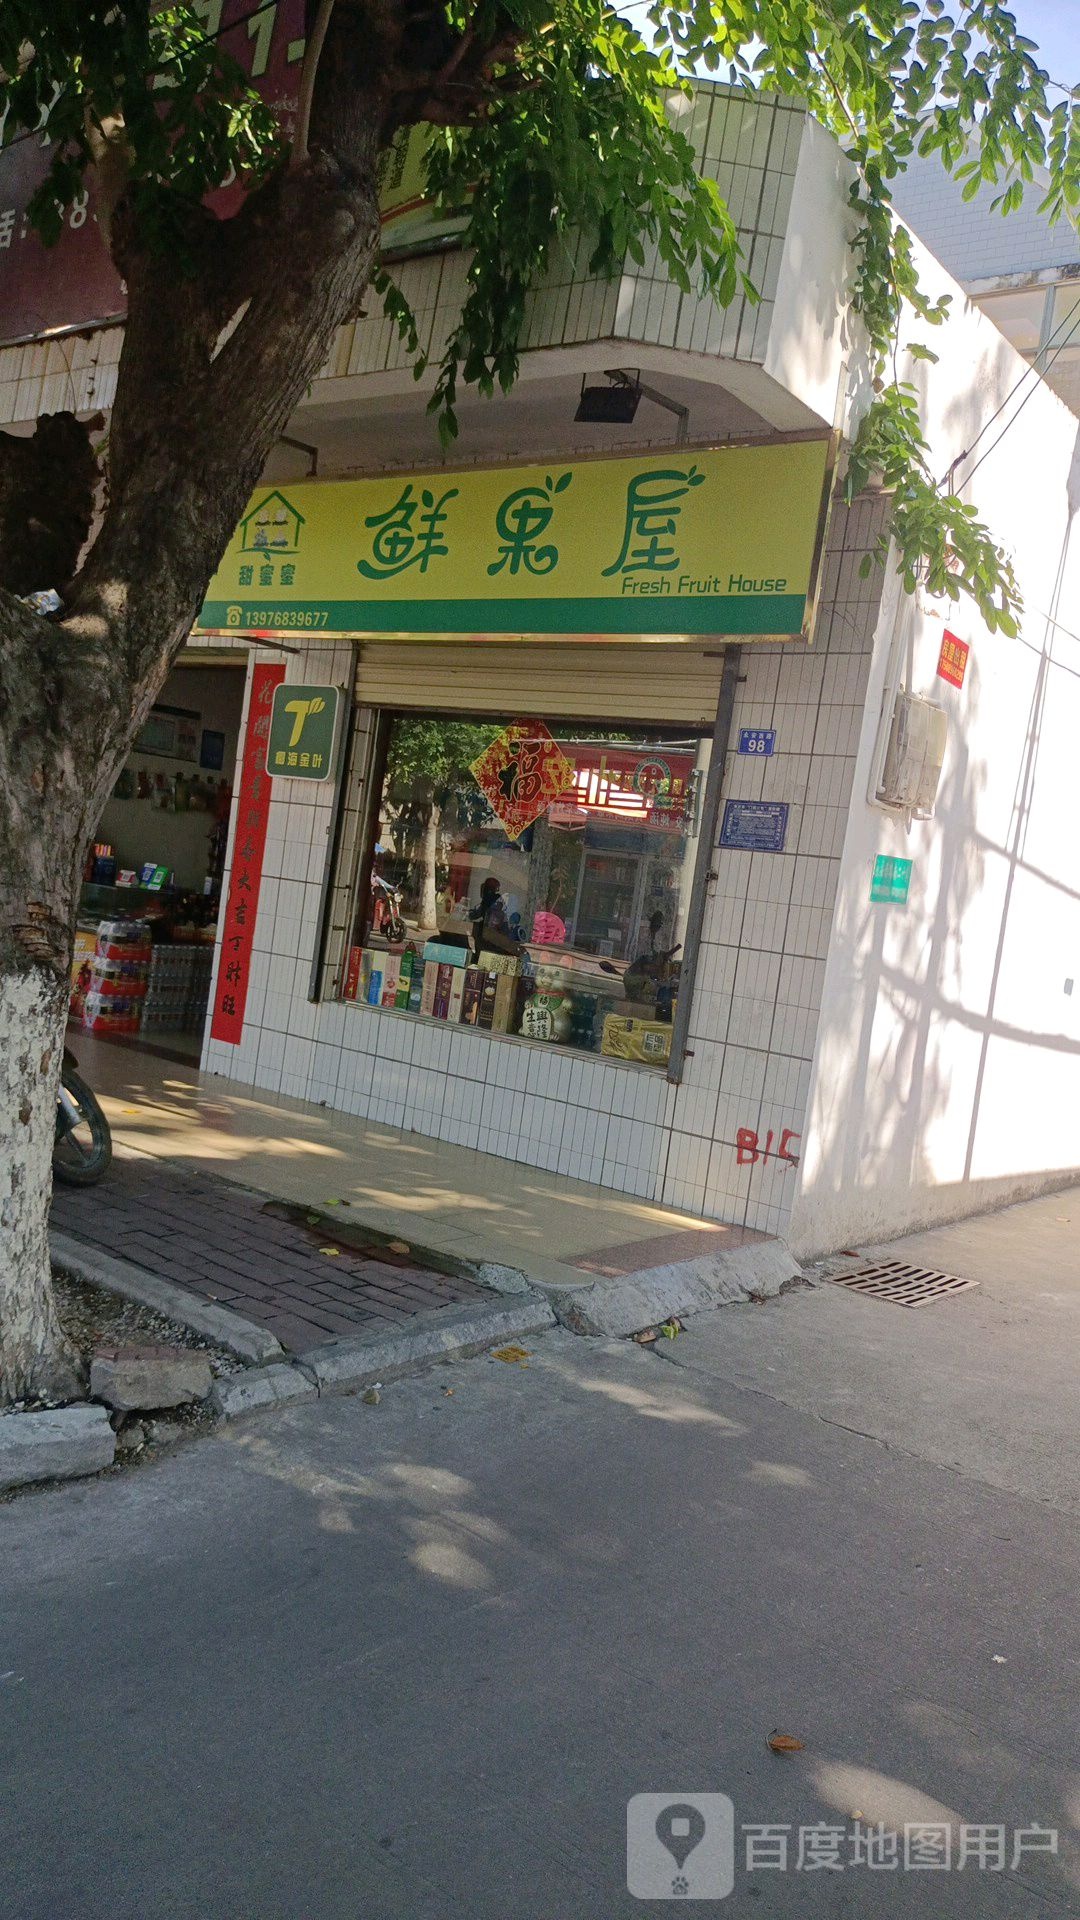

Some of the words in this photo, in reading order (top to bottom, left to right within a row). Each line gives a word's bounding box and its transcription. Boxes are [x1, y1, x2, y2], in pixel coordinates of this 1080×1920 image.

[357, 465, 705, 580] 鲜果屋
[622, 577, 671, 595] Fresh
[678, 575, 721, 594] Fruit
[728, 574, 787, 593] House
[246, 611, 329, 627] 13976839677
[748, 739, 766, 753] 98
